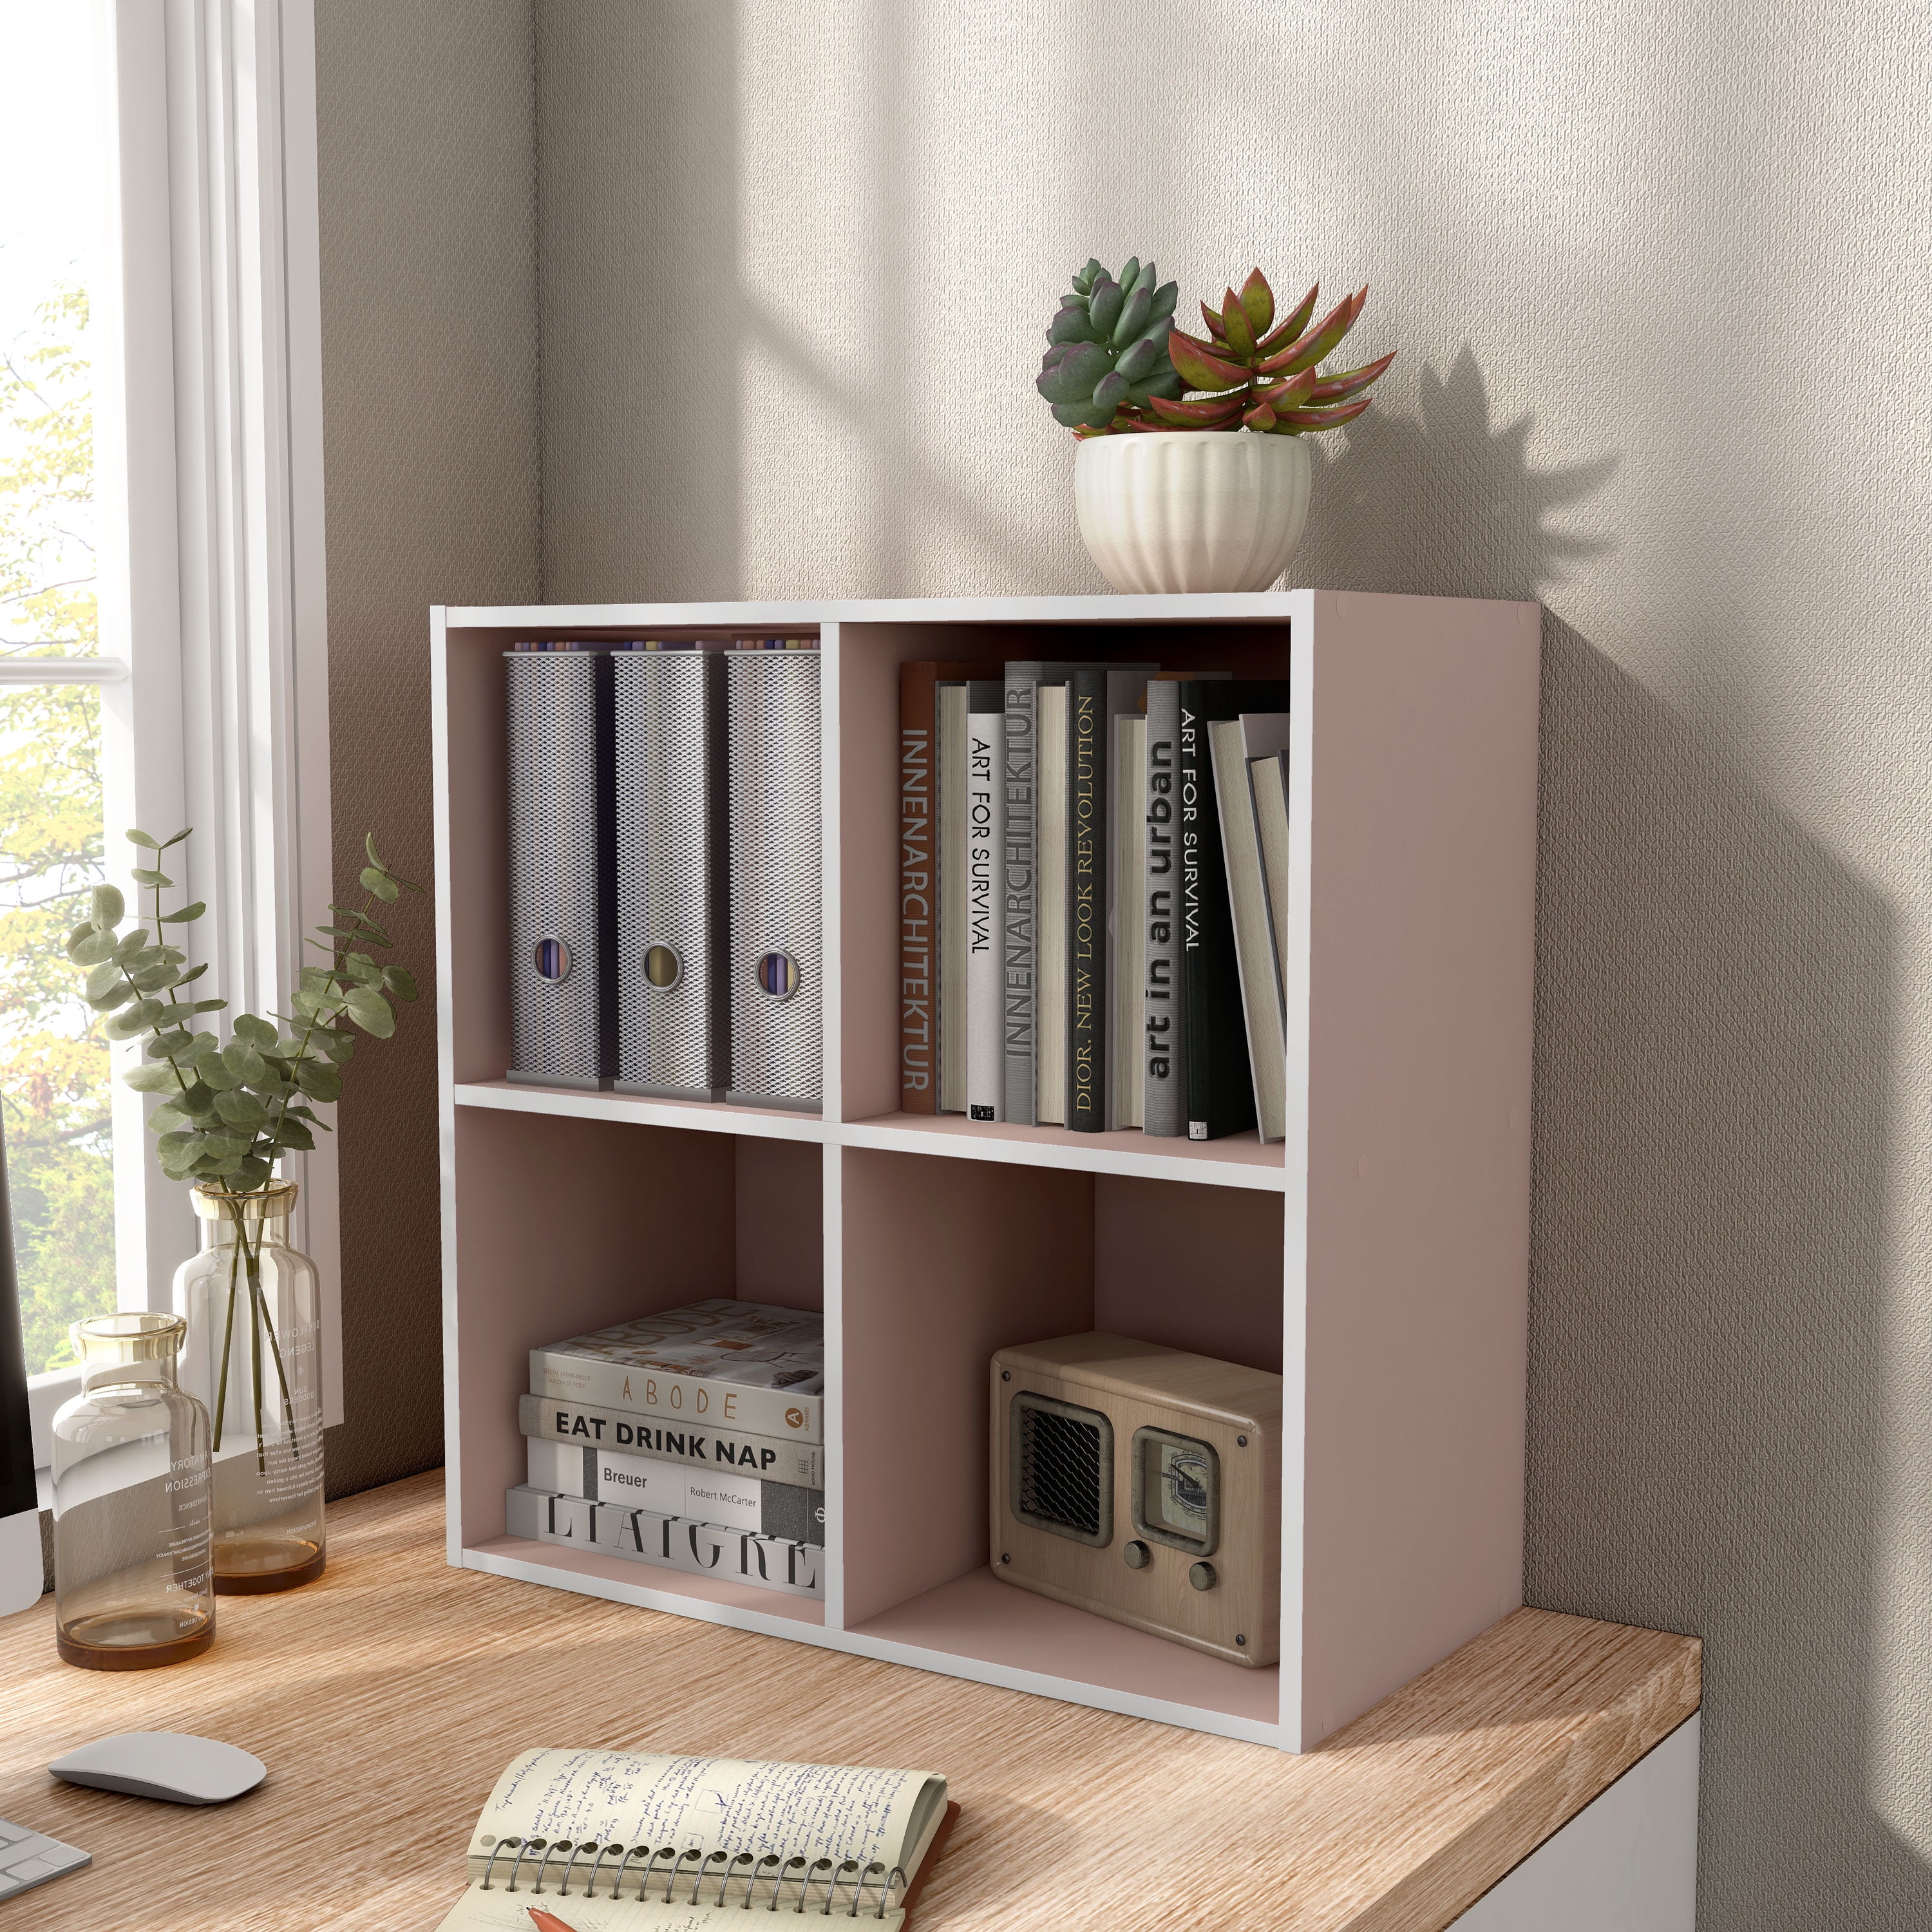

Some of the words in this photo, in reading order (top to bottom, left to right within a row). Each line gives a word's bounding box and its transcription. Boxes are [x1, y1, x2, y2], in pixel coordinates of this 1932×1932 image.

[971, 737, 990, 782] ART
[1181, 707, 1197, 759] ART
[1077, 695, 1094, 874] REVOLUTION
[1146, 741, 1171, 874] urban
[1182, 768, 1197, 822] FOR
[972, 791, 990, 839] FOR
[1006, 687, 1032, 1057] INNENARCHITEKTUR
[1184, 833, 1200, 952] SURVIVAL
[902, 728, 929, 1092] INNENARCHITEKTUR
[971, 848, 990, 954] SURVIVAL
[1077, 882, 1093, 958] LOOK
[1150, 890, 1171, 943] an
[1076, 969, 1092, 1032] NEW
[1146, 960, 1171, 998] in
[1075, 1038, 1092, 1112] DIOR.
[1150, 1016, 1171, 1080] art
[566, 1303, 761, 1355] ABODE
[543, 1368, 559, 1376] SERENA
[548, 1378, 565, 1386] MASON
[622, 1376, 737, 1420] ABODE
[556, 1412, 607, 1440] EAT
[616, 1422, 706, 1460] DRINK
[715, 1440, 777, 1471] NAP
[603, 1468, 647, 1489] Breuer
[690, 1486, 717, 1502] Robert
[719, 1491, 756, 1508] McCarter
